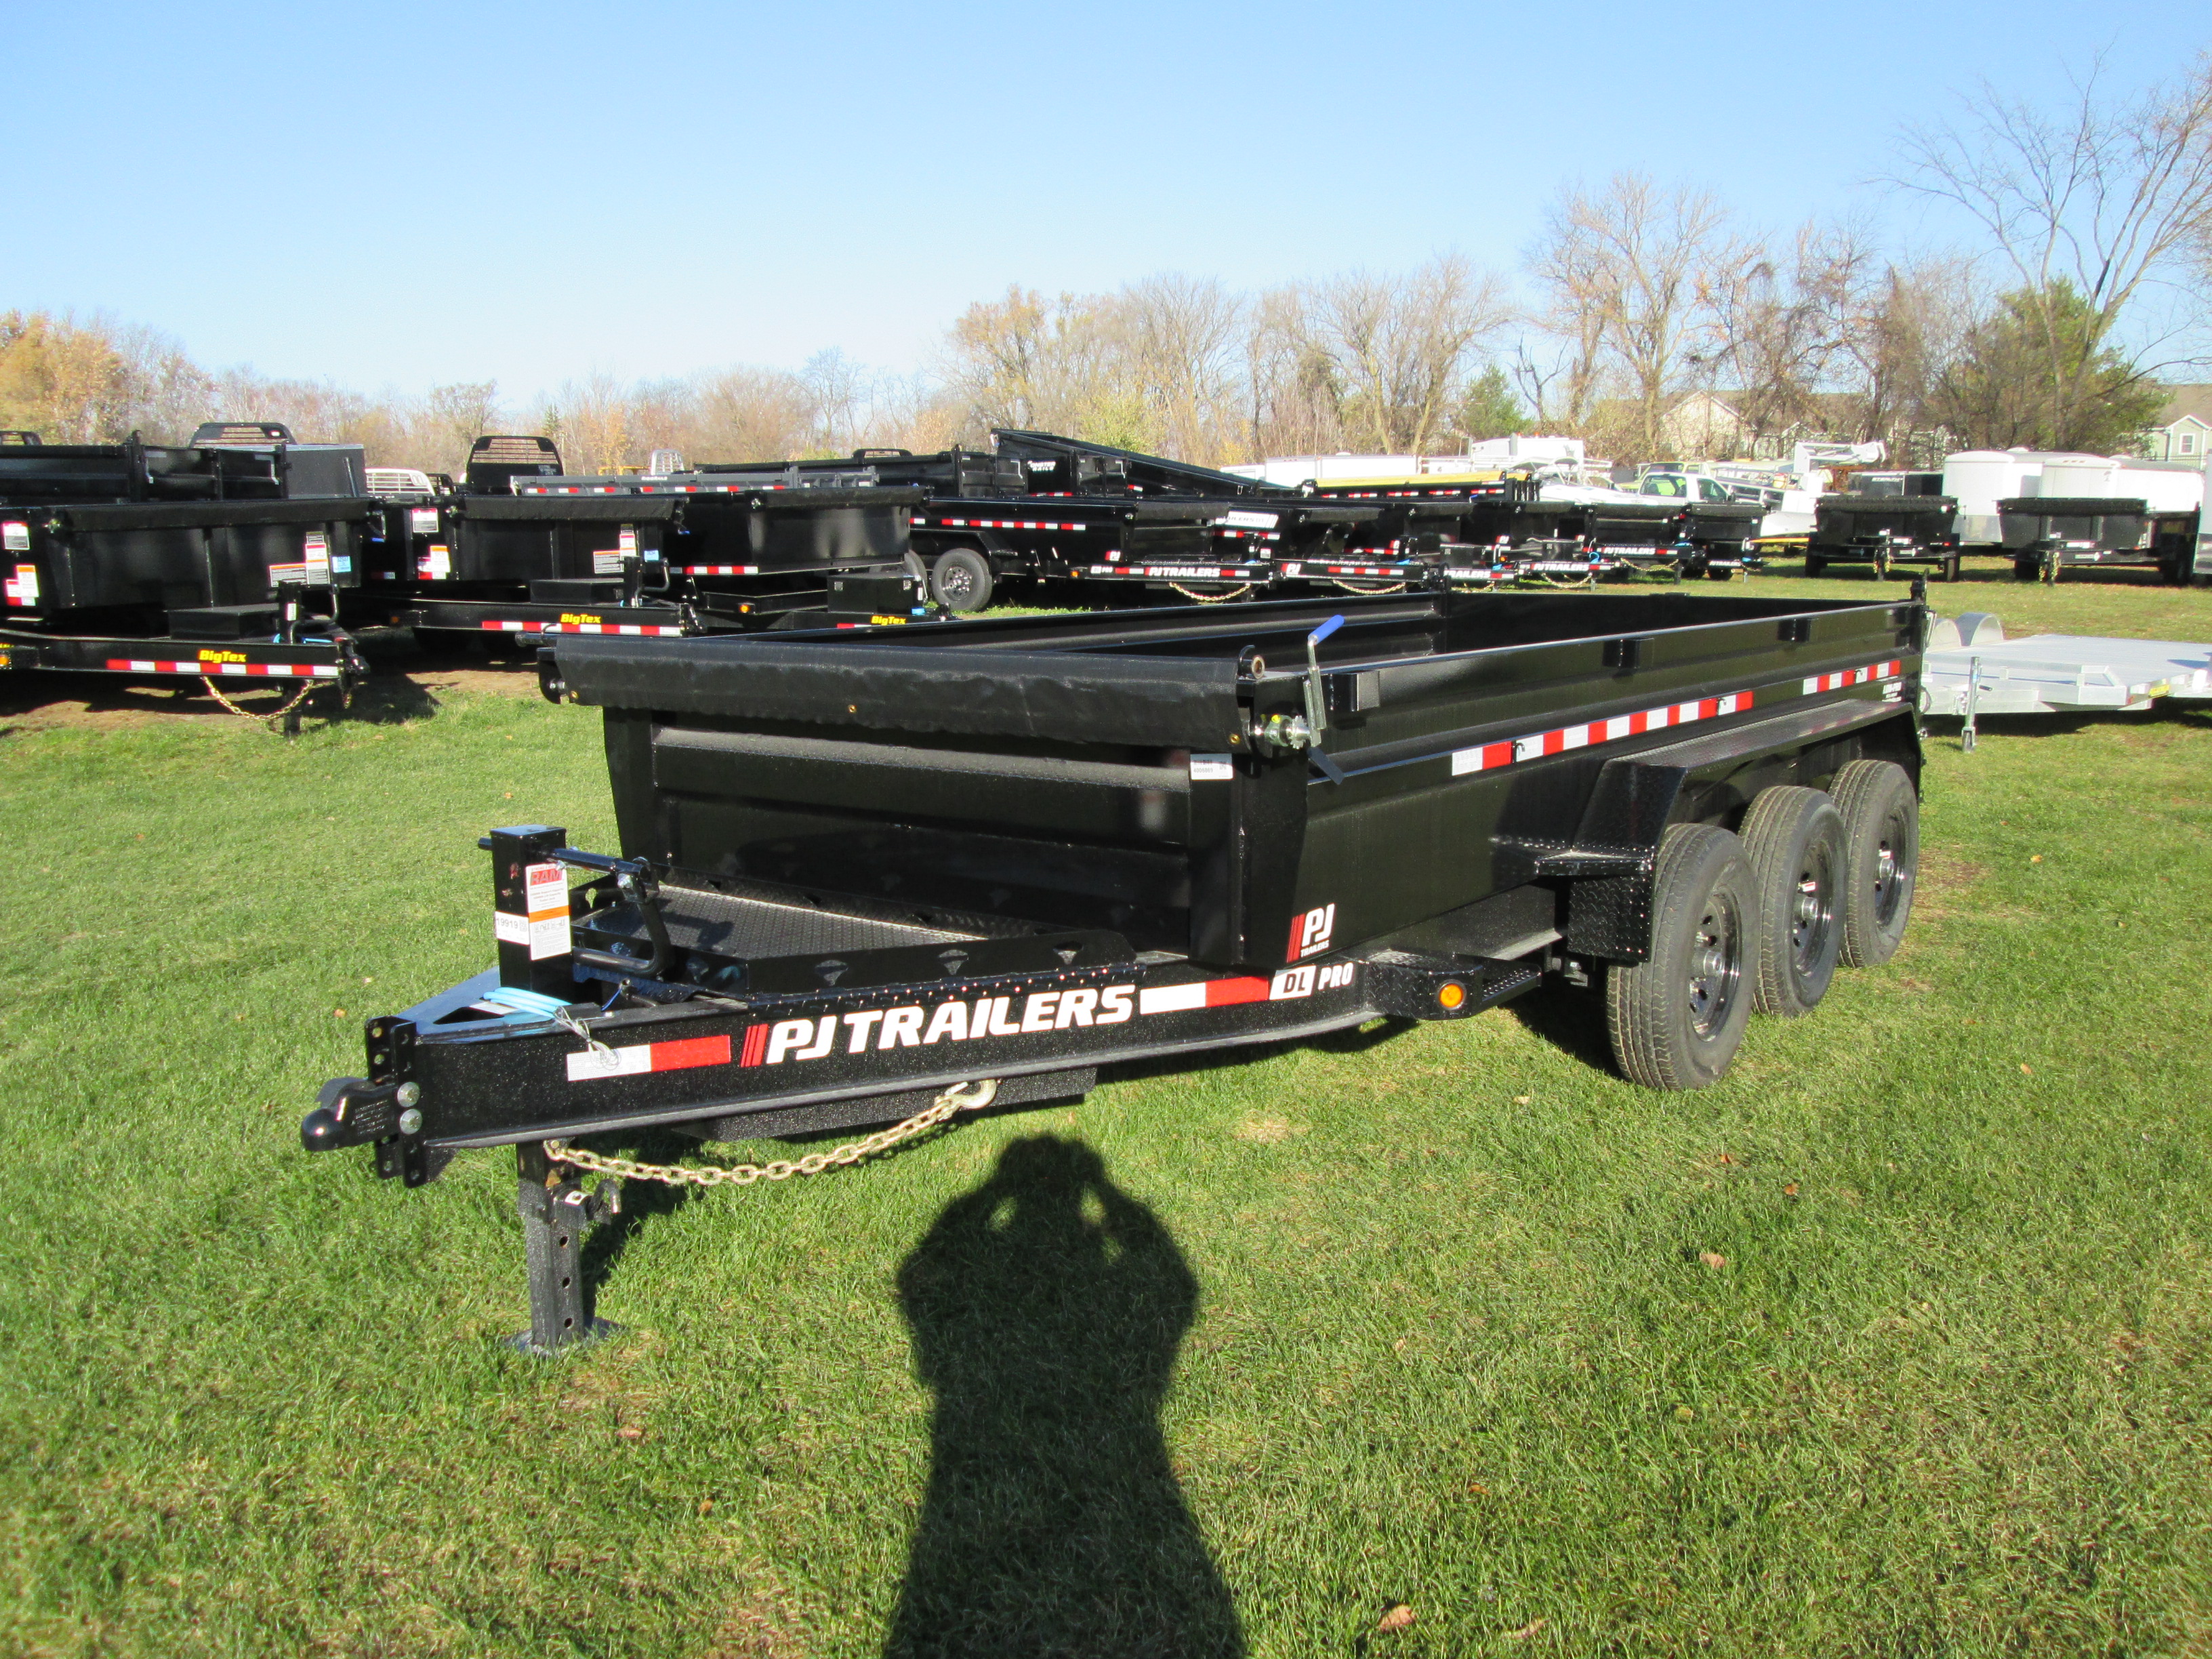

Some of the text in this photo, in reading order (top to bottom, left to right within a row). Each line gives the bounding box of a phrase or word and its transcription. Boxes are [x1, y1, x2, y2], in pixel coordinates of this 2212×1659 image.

[560, 613, 601, 625] BigTex
[871, 615, 906, 626] BigTex
[199, 650, 247, 663] BigTex
[531, 869, 562, 885] RAM
[496, 918, 518, 929] 19919
[1301, 903, 1335, 947] PJ
[1300, 939, 1330, 958] TRAILERS
[1283, 962, 1354, 994] DL PRO
